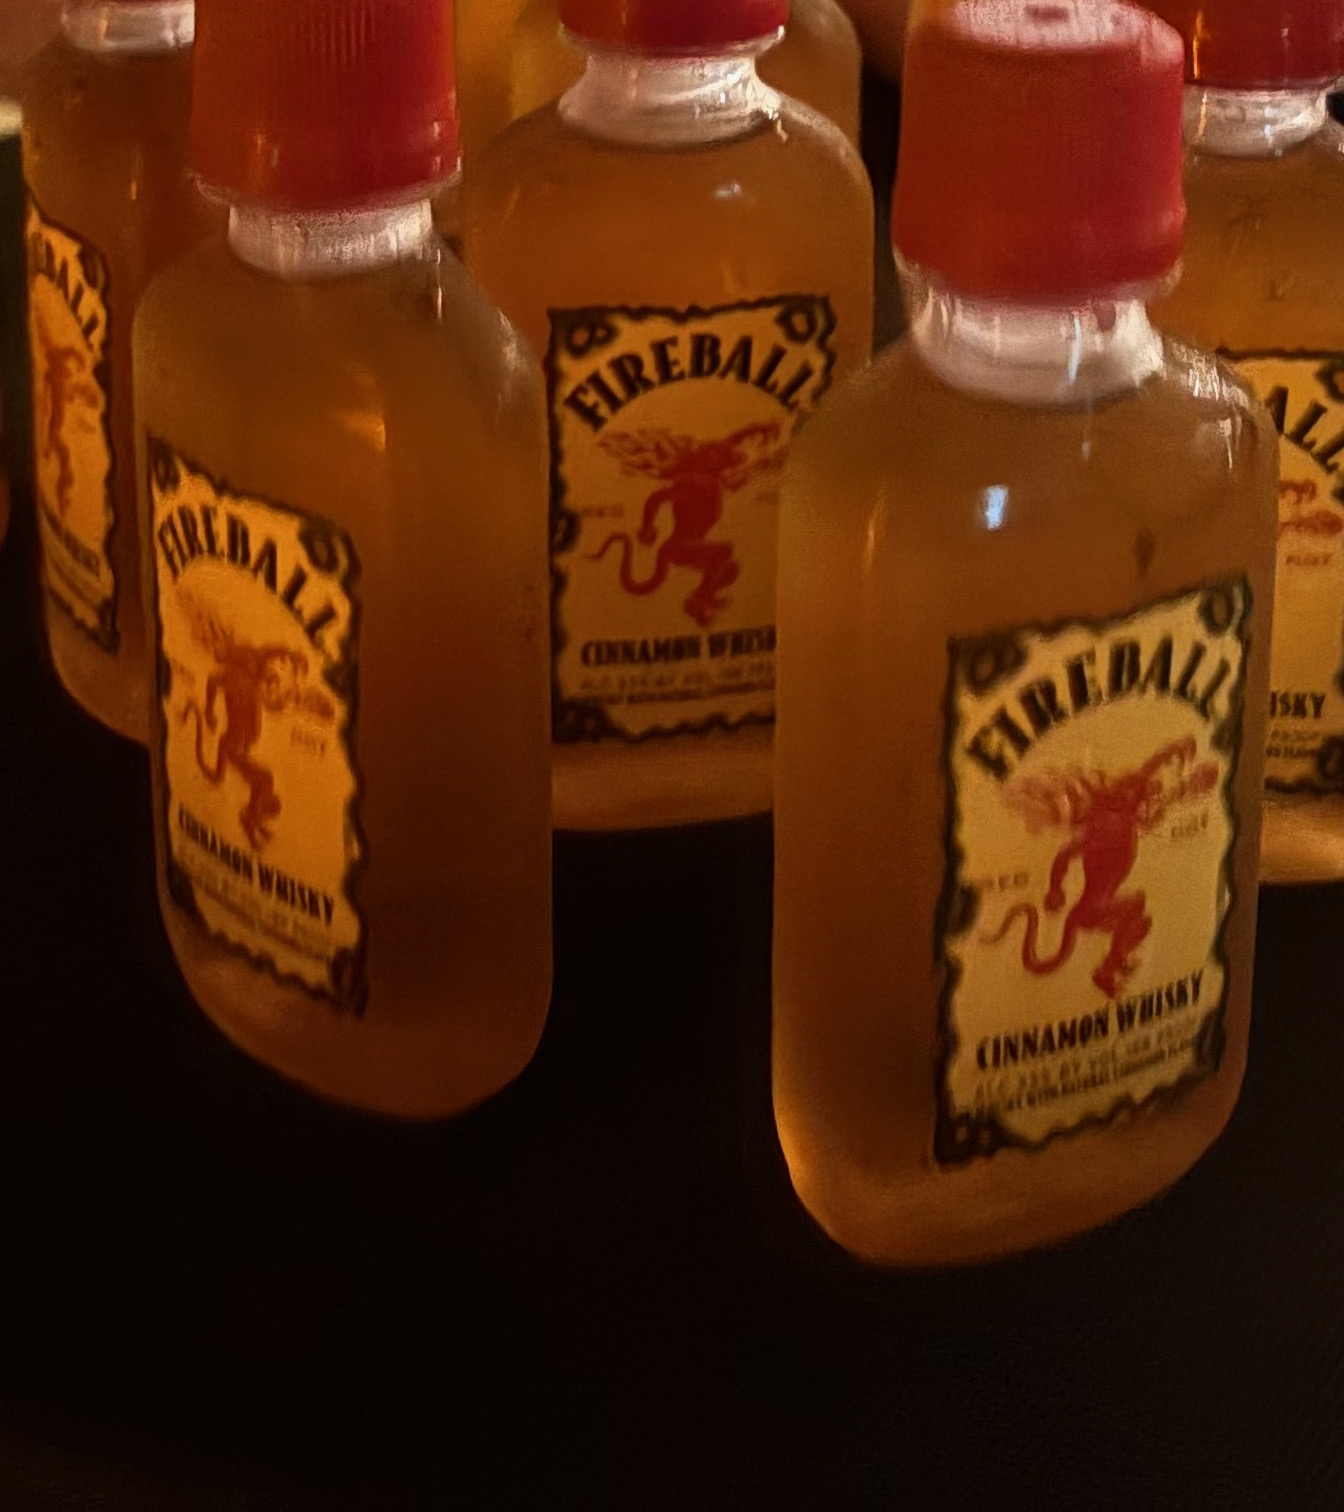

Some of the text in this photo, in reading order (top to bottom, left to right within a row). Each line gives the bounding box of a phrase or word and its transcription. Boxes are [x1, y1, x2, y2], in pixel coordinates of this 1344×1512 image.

[563, 332, 817, 431] FIREBALL
[156, 502, 340, 650] FIREBALL
[968, 635, 1232, 782] FIREBALL
[258, 860, 334, 927] WHISKY
[976, 1005, 1109, 1071] CINNAMON
[1115, 967, 1205, 1033] WHISKY
